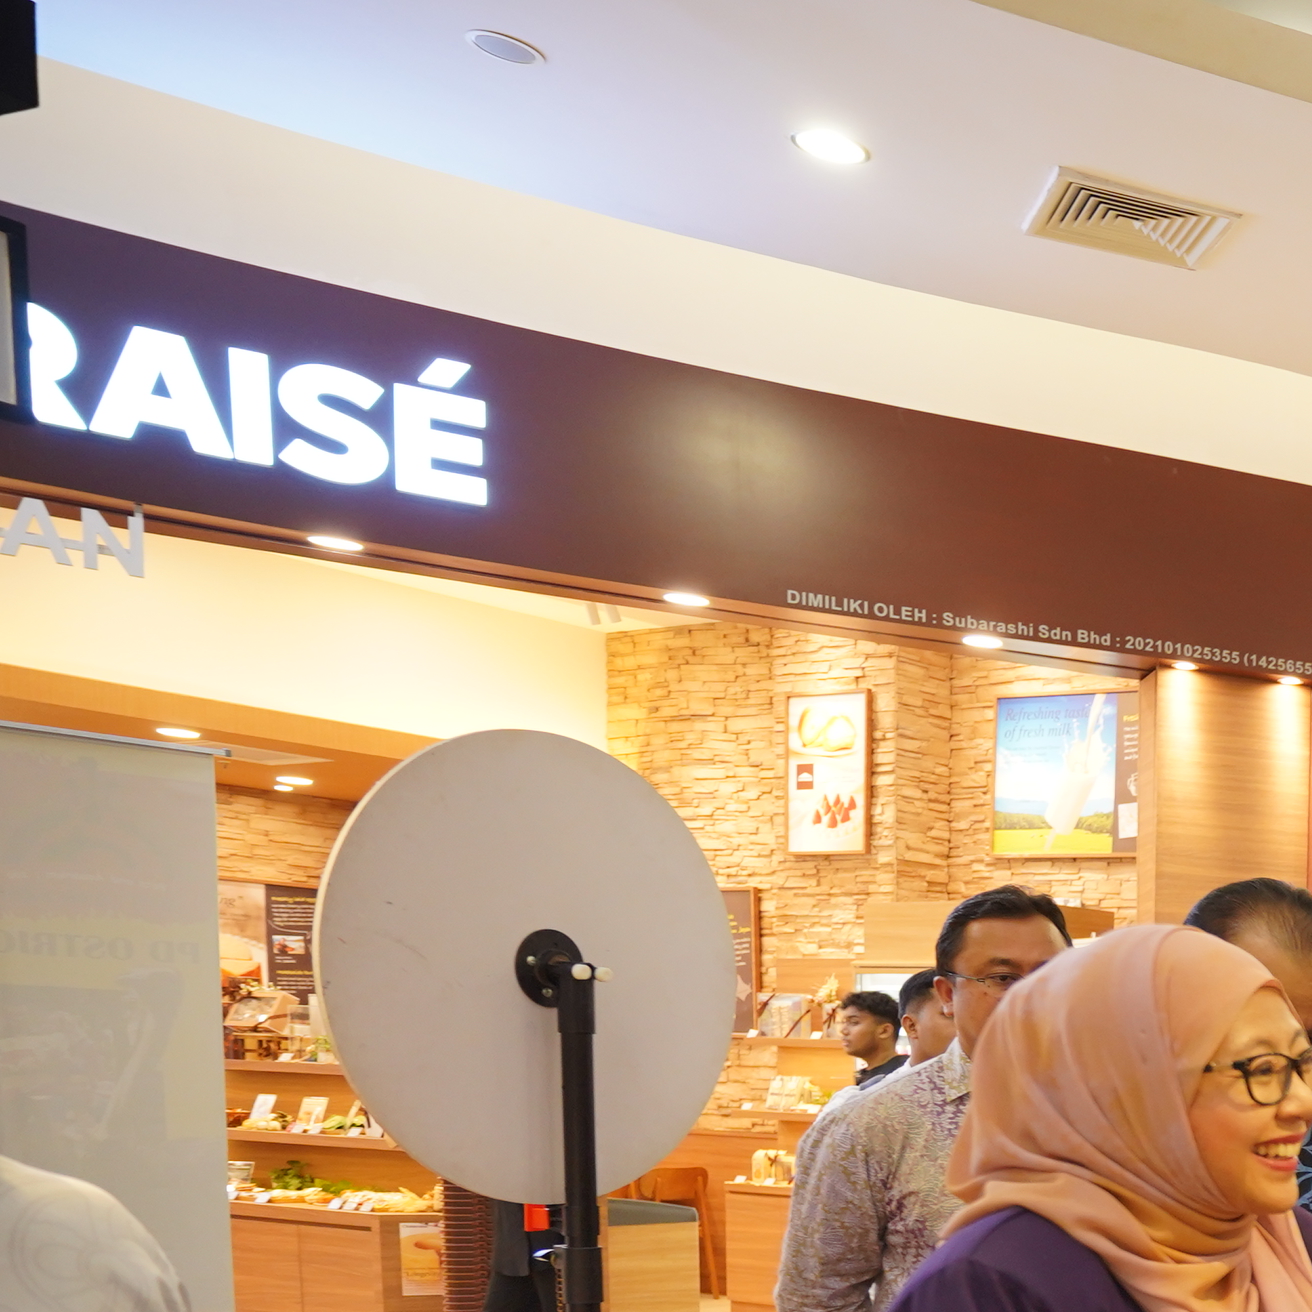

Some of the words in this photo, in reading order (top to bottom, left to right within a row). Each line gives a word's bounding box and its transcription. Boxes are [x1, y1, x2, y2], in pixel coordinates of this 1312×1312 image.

[786, 588, 869, 616] DIMILIKI
[873, 601, 927, 624] OLEH
[942, 611, 1034, 639] Subarashi
[1038, 624, 1073, 643] Sdn
[1076, 628, 1112, 647] Bhd
[1124, 635, 1241, 665] 202101025355
